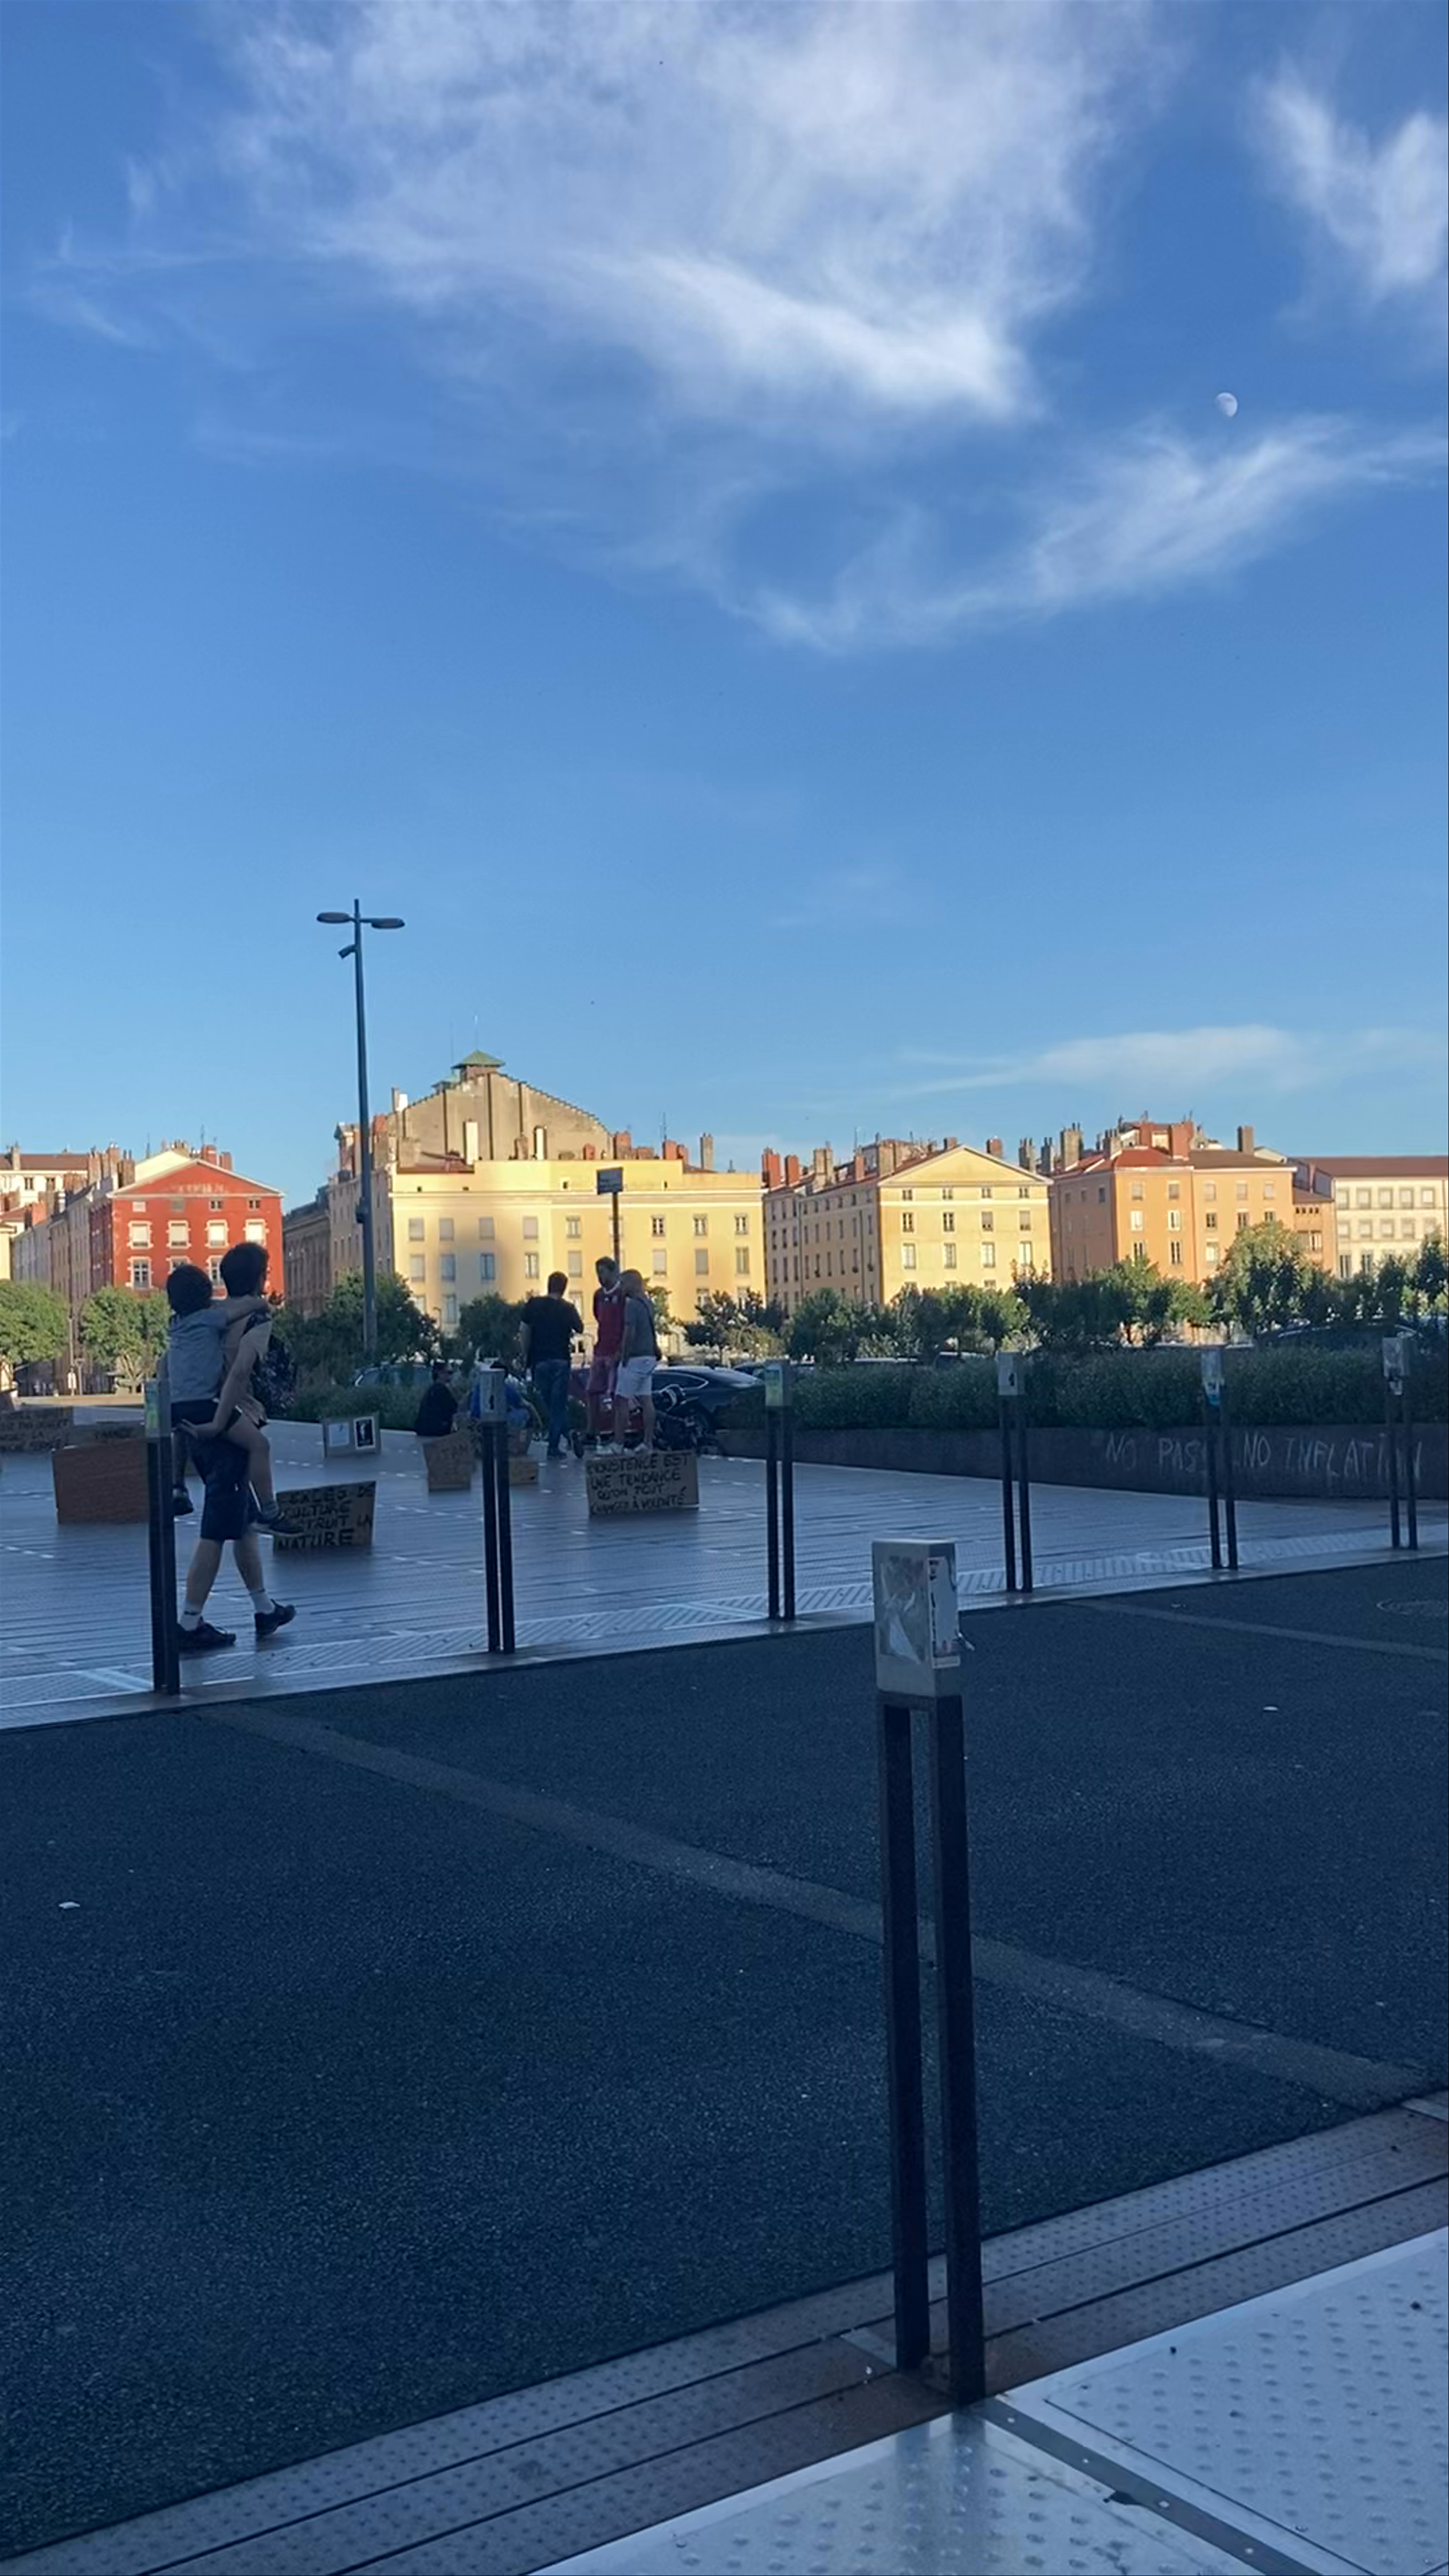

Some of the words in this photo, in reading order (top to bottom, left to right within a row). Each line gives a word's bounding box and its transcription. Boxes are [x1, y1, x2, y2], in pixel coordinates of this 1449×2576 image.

[1105, 1432, 1137, 1471] NO
[1244, 1431, 1272, 1468] NO
[619, 1467, 681, 1487] TENDANCE
[283, 1499, 353, 1518] CULTURE
[277, 1528, 354, 1549] NATURE
